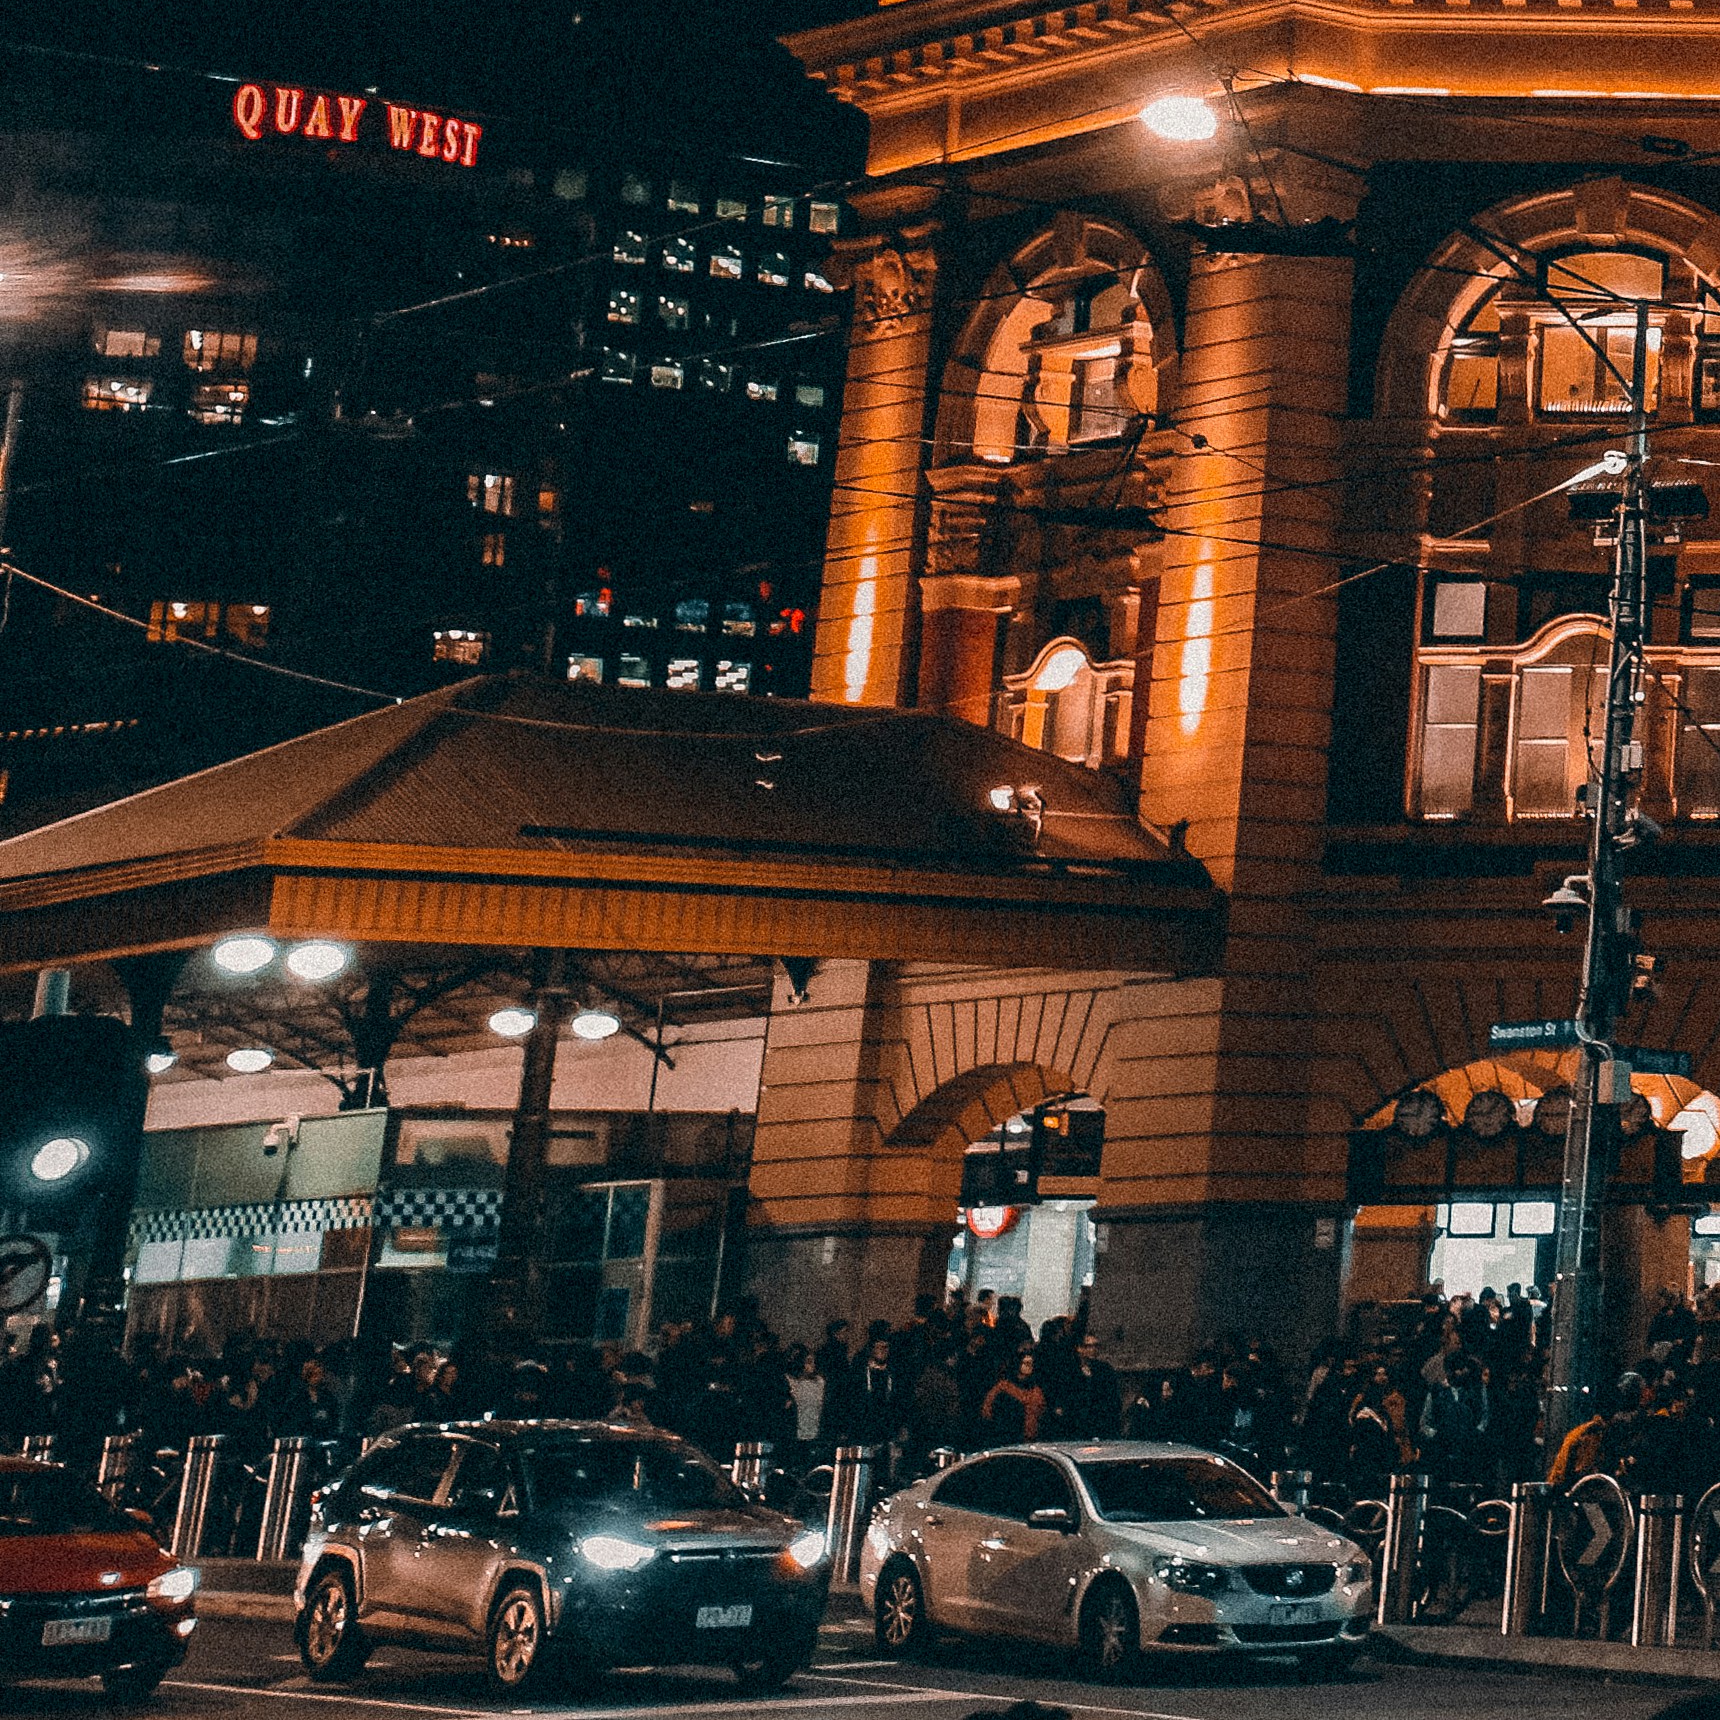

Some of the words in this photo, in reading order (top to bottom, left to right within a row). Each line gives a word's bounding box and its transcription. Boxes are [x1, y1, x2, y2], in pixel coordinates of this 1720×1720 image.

[232, 82, 367, 144] QUAY
[386, 102, 484, 168] WEST
[1490, 1024, 1543, 1041] Swanston
[1544, 1021, 1557, 1037] St
